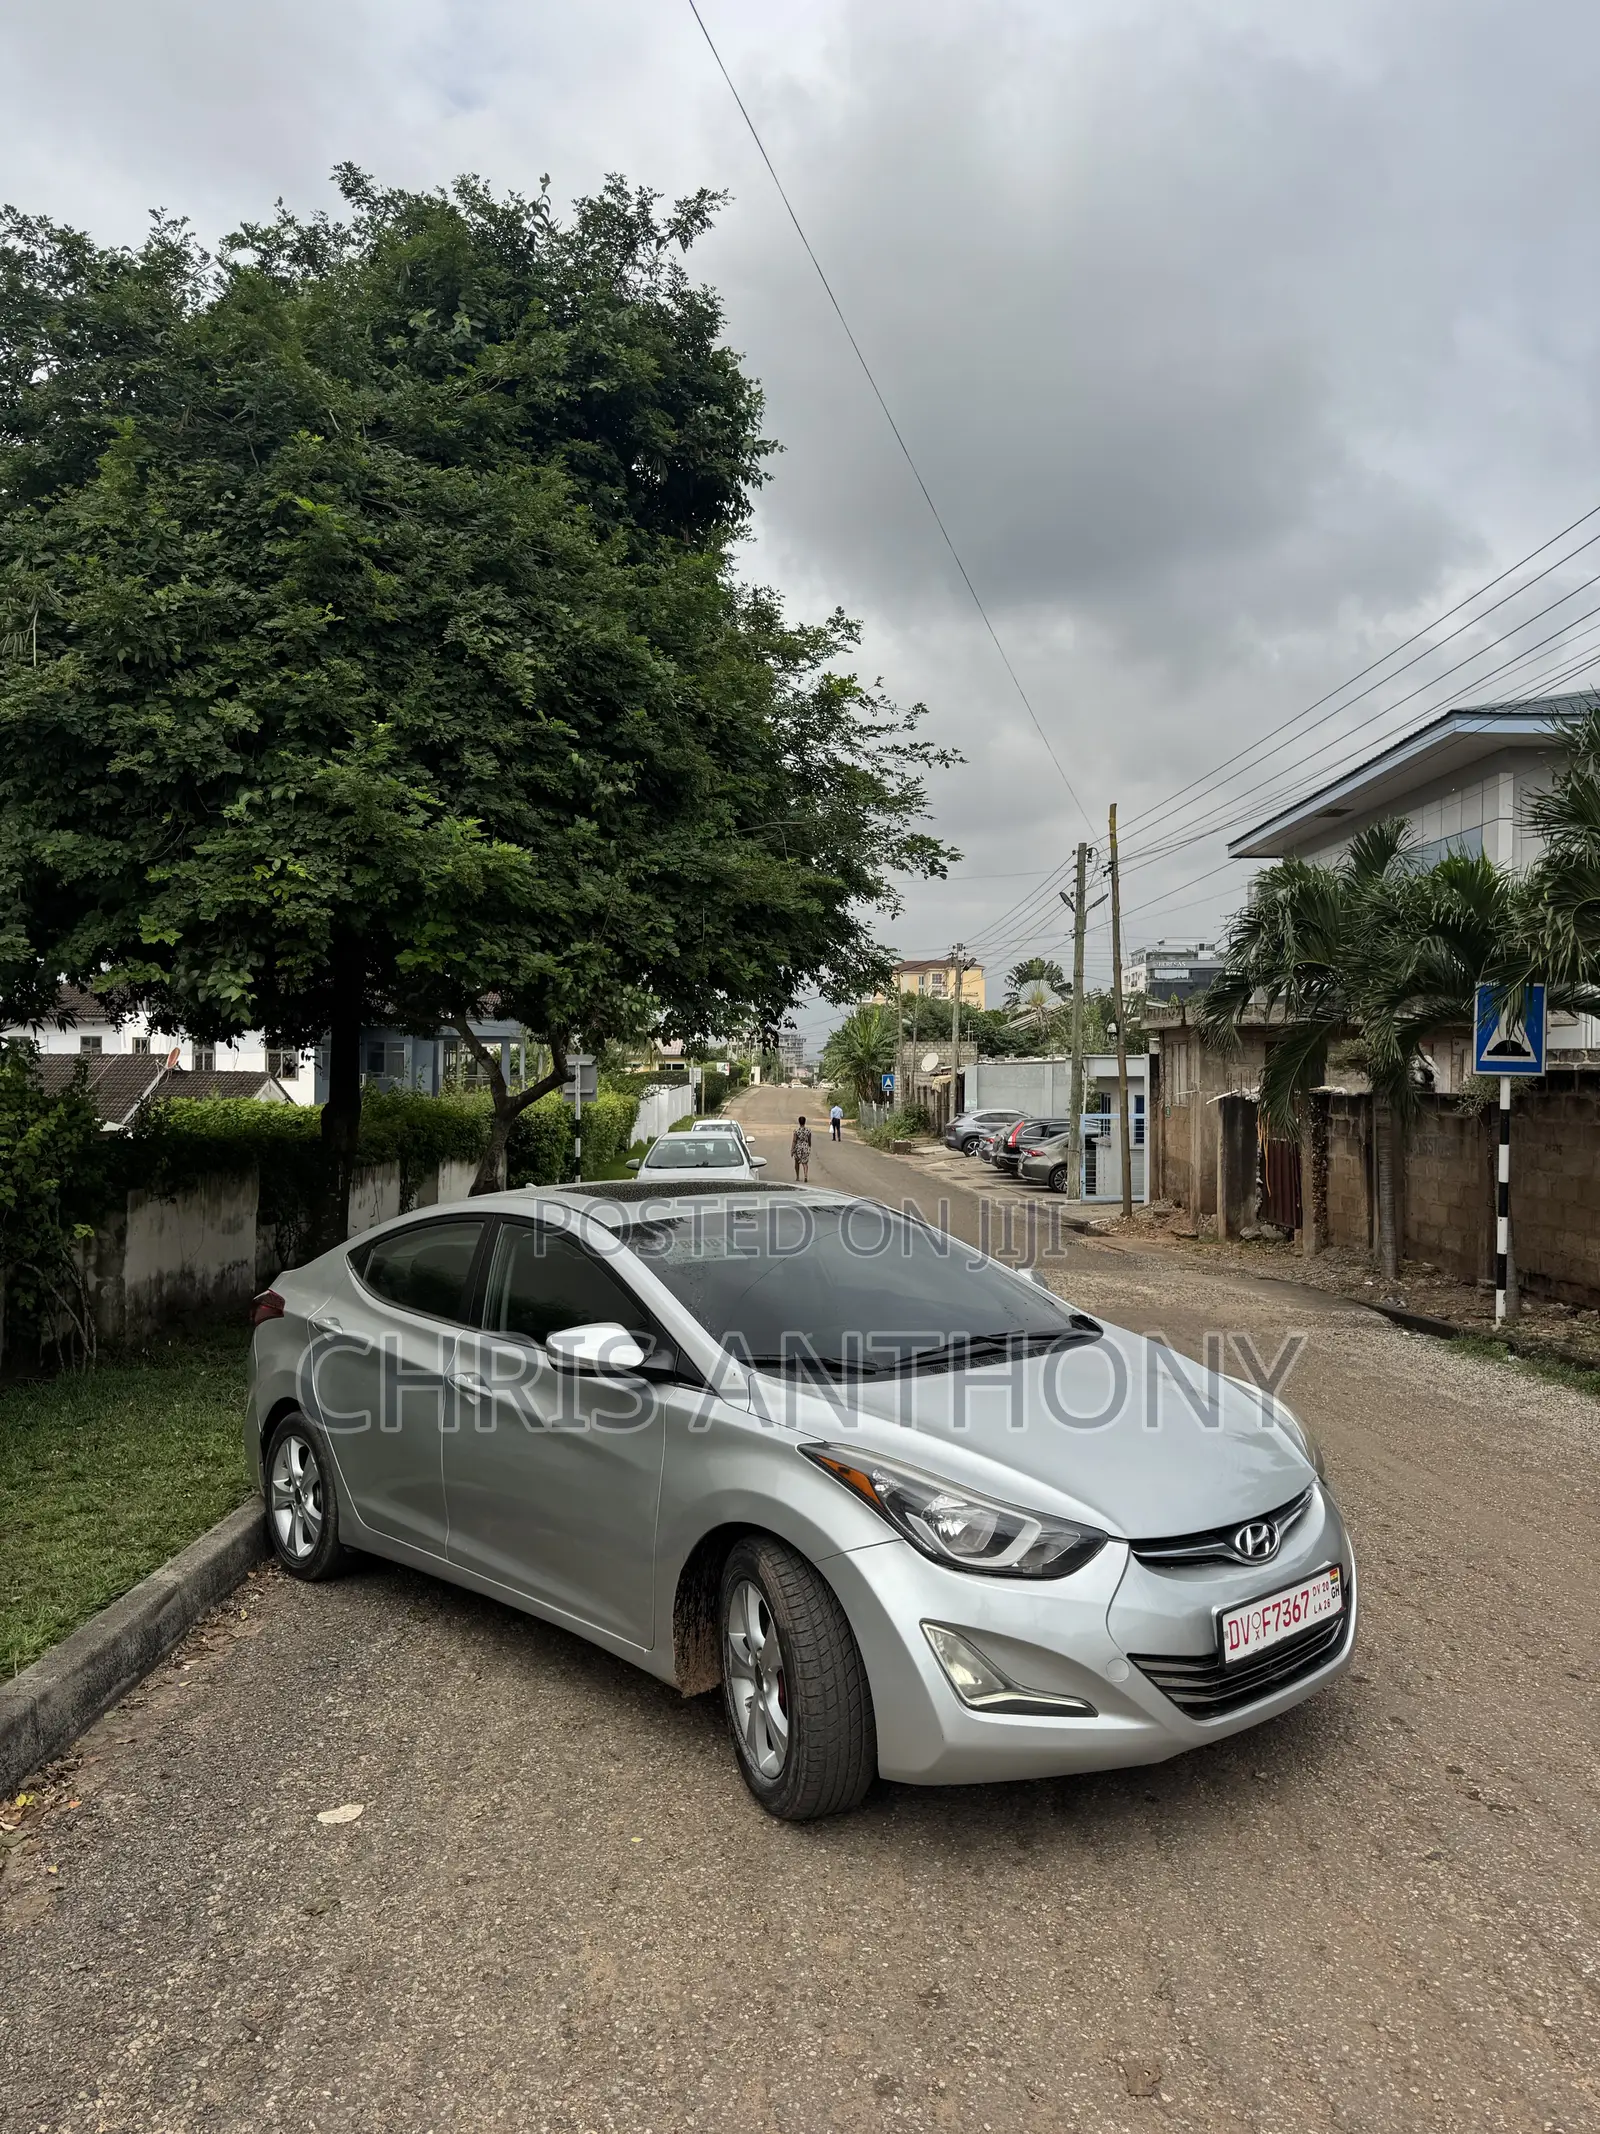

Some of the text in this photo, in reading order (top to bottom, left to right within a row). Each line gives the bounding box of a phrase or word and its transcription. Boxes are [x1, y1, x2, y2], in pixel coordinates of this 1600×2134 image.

[1331, 1584, 1340, 1598] GH
[1228, 1590, 1309, 1650] DV F7367
